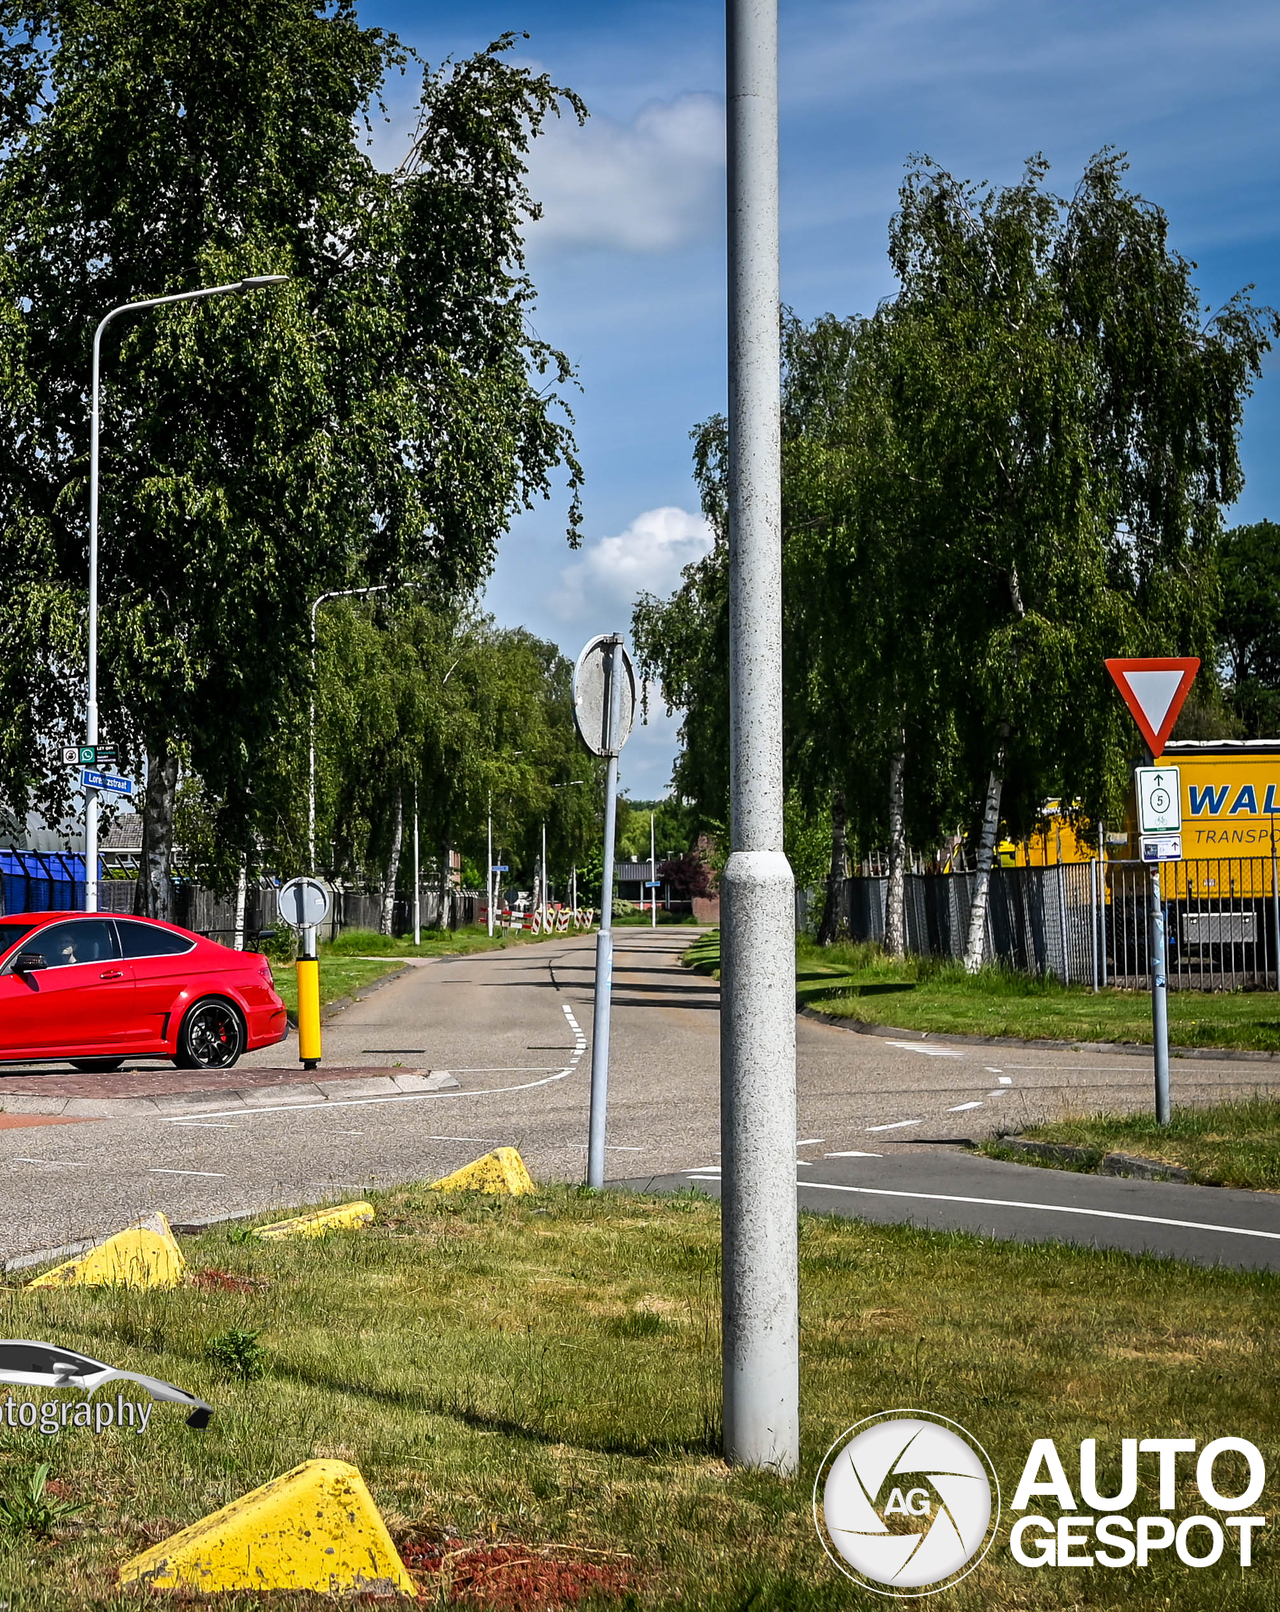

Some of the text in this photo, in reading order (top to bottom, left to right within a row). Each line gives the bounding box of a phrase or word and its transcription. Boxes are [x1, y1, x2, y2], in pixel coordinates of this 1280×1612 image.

[88, 773, 127, 790] Lorezstraat
[1156, 795, 1164, 807] 5
[1187, 784, 1280, 816] WAL
